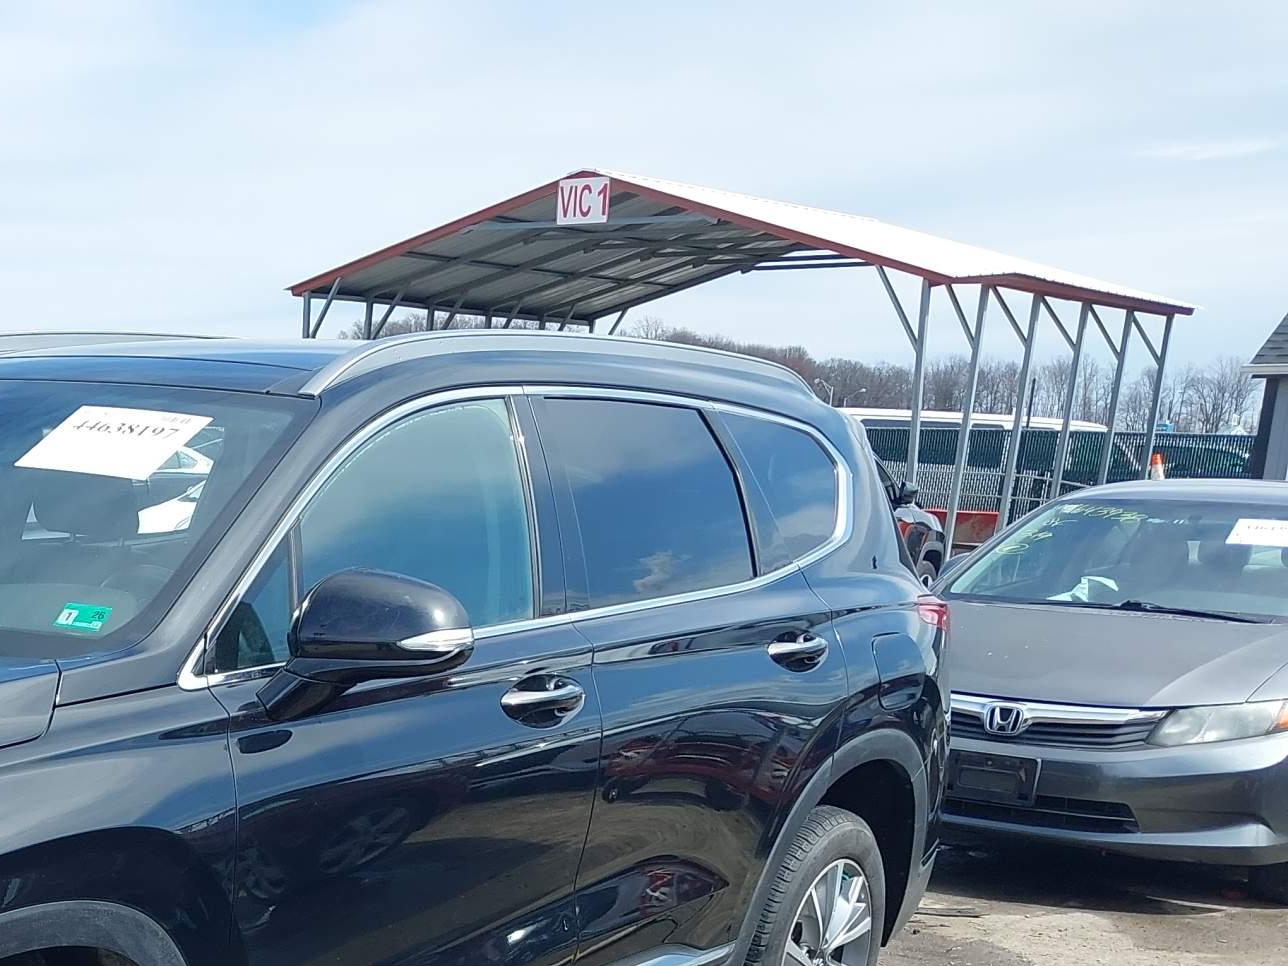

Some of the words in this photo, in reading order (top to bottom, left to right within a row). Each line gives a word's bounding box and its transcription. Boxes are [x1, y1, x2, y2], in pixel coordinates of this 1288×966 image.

[560, 184, 592, 218] VIC
[597, 183, 608, 216] 1
[91, 610, 106, 620] 26
